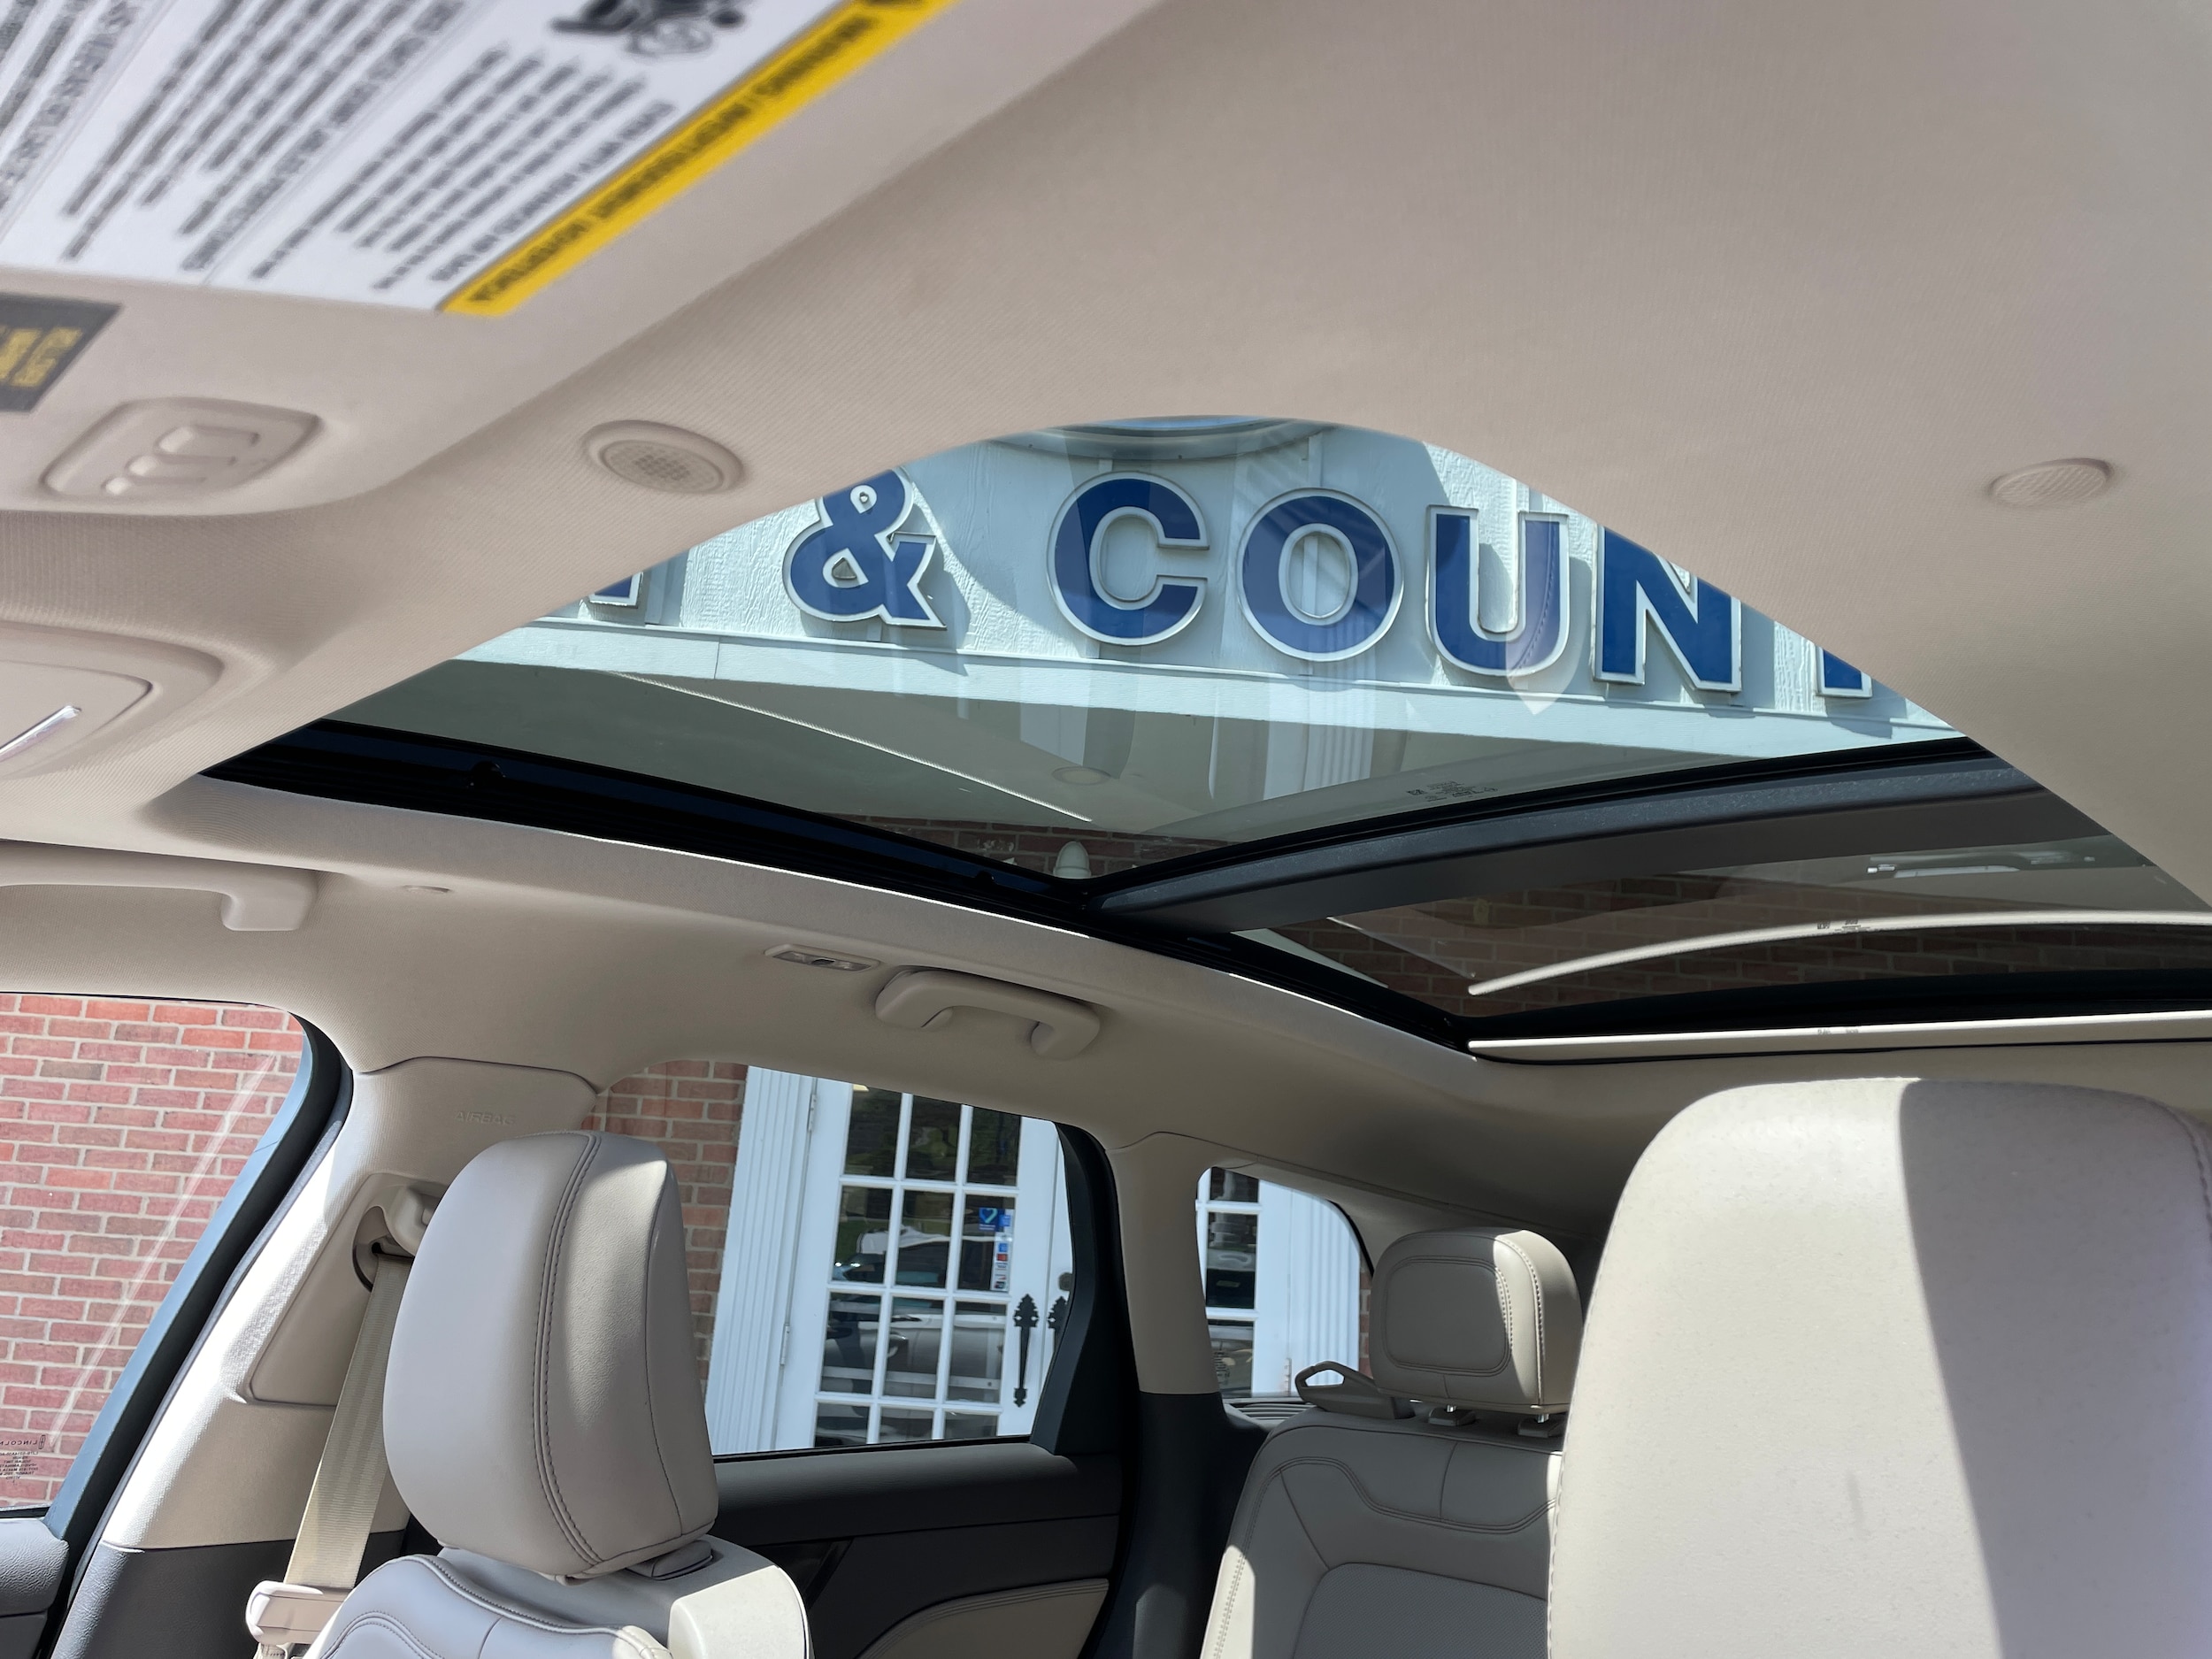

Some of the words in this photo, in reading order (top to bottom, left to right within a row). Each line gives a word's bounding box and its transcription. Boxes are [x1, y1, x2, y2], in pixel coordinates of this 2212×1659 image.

[783, 467, 947, 631] &
[1047, 471, 1872, 699] COUN
[454, 1110, 517, 1125] AIRBAG
